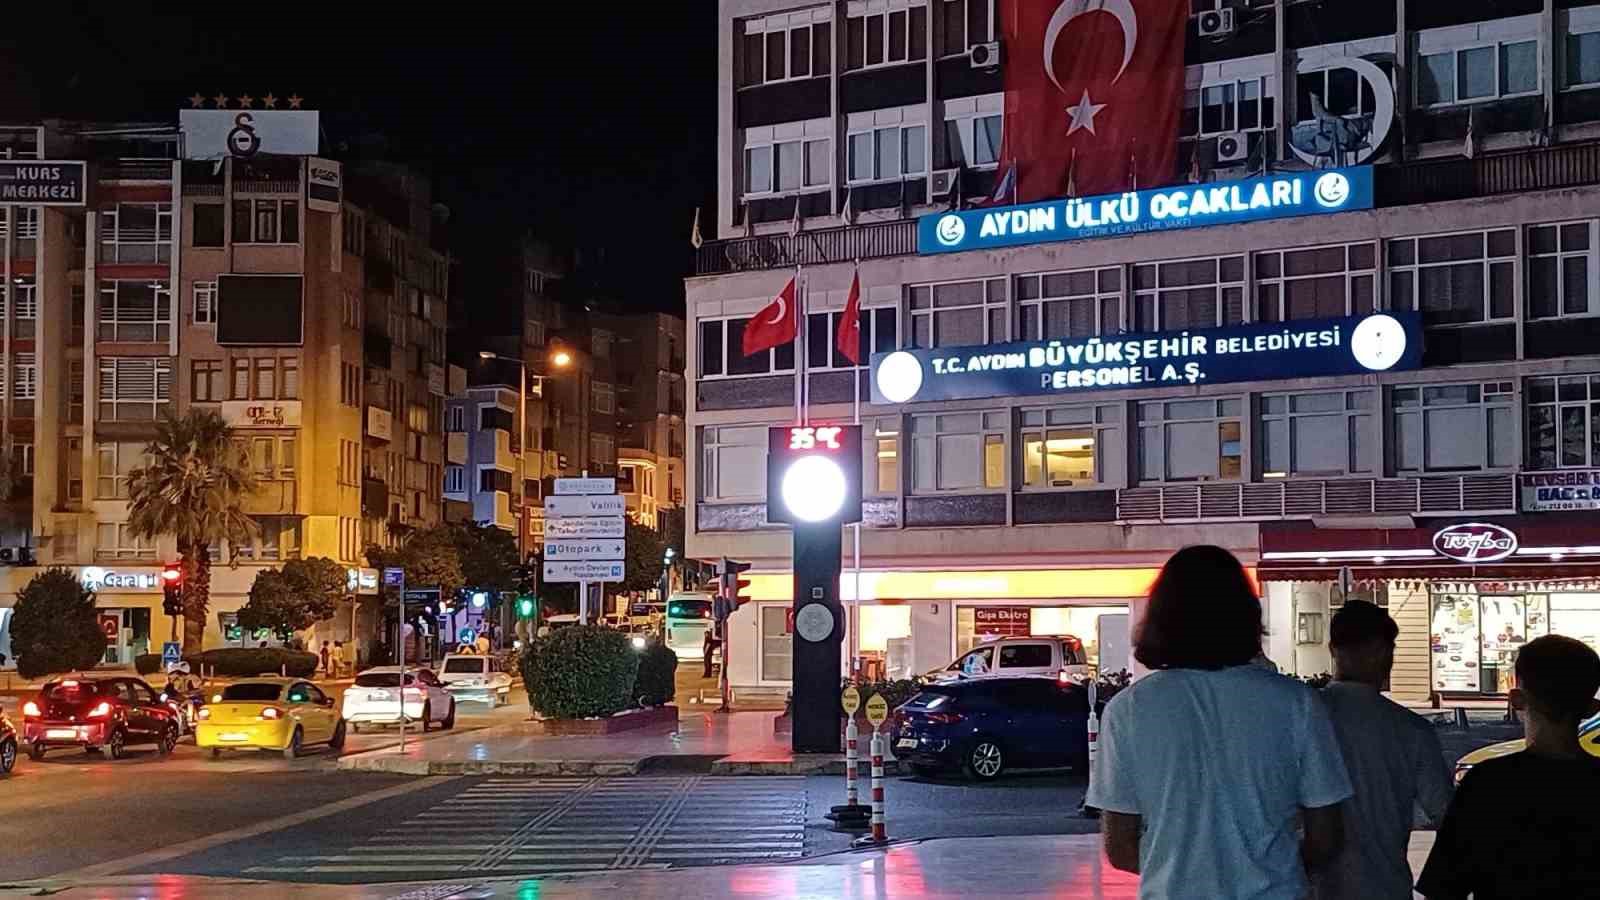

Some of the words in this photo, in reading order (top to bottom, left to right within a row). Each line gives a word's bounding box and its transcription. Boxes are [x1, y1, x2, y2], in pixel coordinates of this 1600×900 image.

[16, 167, 61, 180] KURS
[2, 181, 76, 199] MERKEZİ
[980, 207, 1055, 237] AYDIN
[1065, 193, 1139, 228] ÜLKÜ
[1150, 179, 1301, 219] OCAKLARI
[932, 358, 965, 374] T.C.
[967, 353, 1026, 372] AYDIN
[1029, 331, 1208, 368] BÜYÜKŞEHİR
[1215, 325, 1341, 354] BELEDİYESİ
[1041, 365, 1156, 389] PERSONEL
[1161, 362, 1206, 384] A.Ş.
[789, 427, 816, 449] 35
[591, 501, 622, 510] Valilik
[557, 545, 602, 555] Otopark
